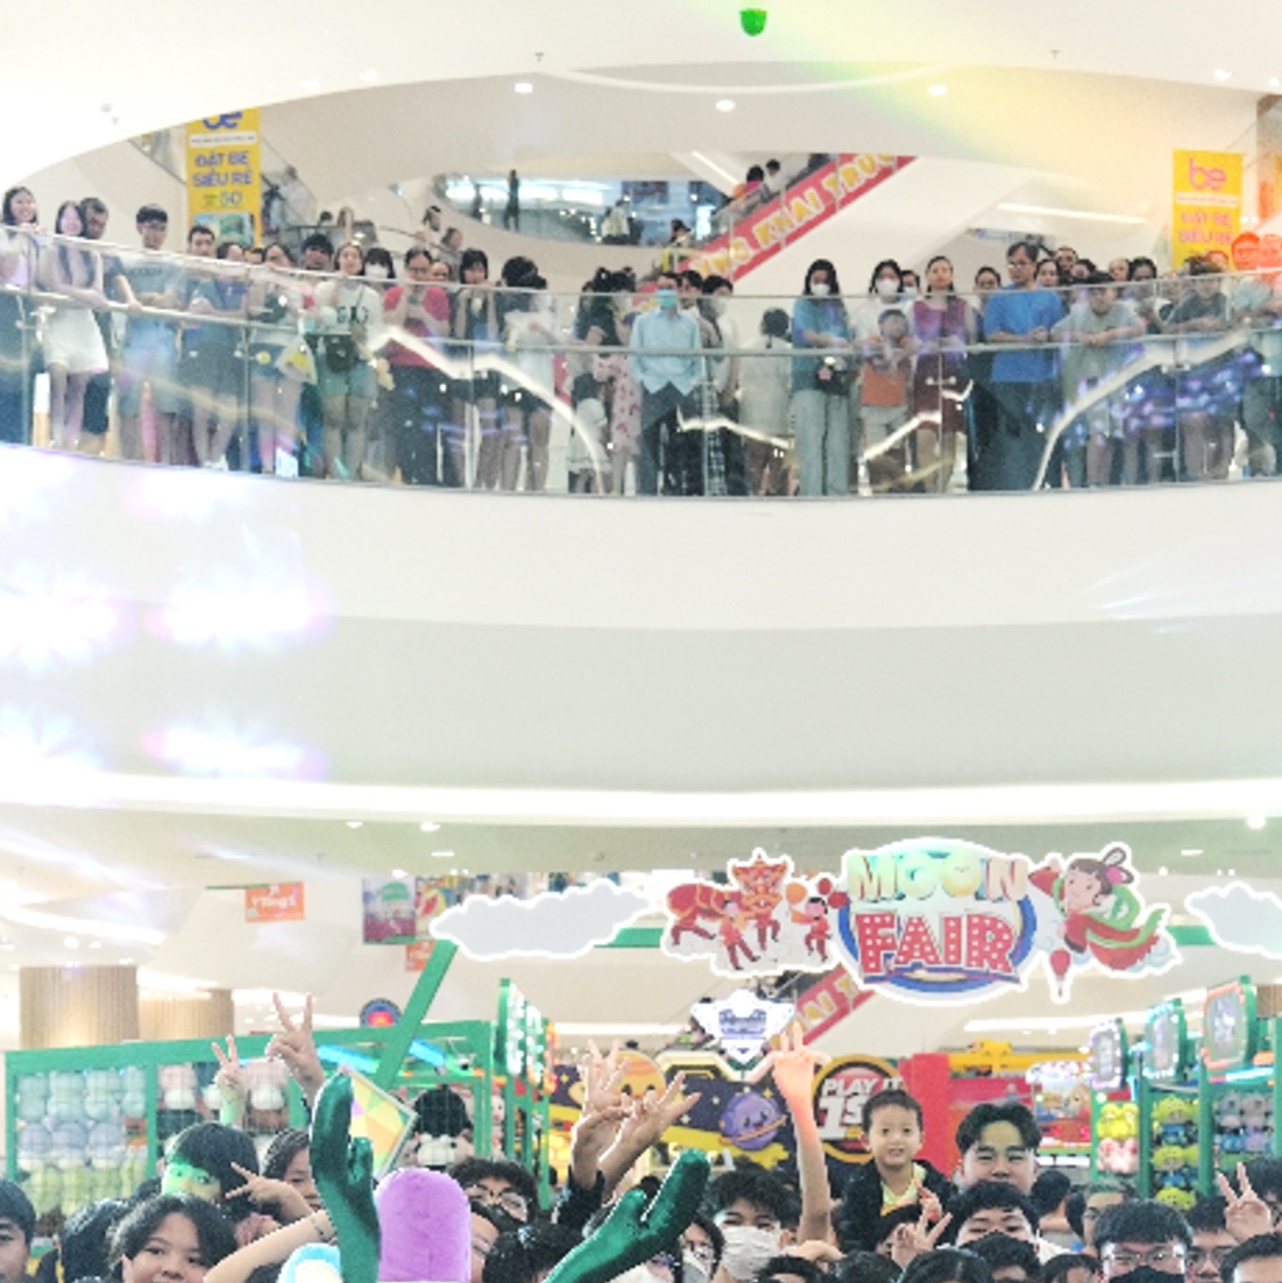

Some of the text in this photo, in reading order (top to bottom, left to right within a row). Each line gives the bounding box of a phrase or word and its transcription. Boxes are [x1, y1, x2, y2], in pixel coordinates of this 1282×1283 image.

[1188, 157, 1228, 191] be
[752, 188, 825, 248] KHAI
[847, 849, 1029, 902] MOON
[854, 909, 1017, 976] FAIR
[822, 1076, 876, 1097] PLAY
